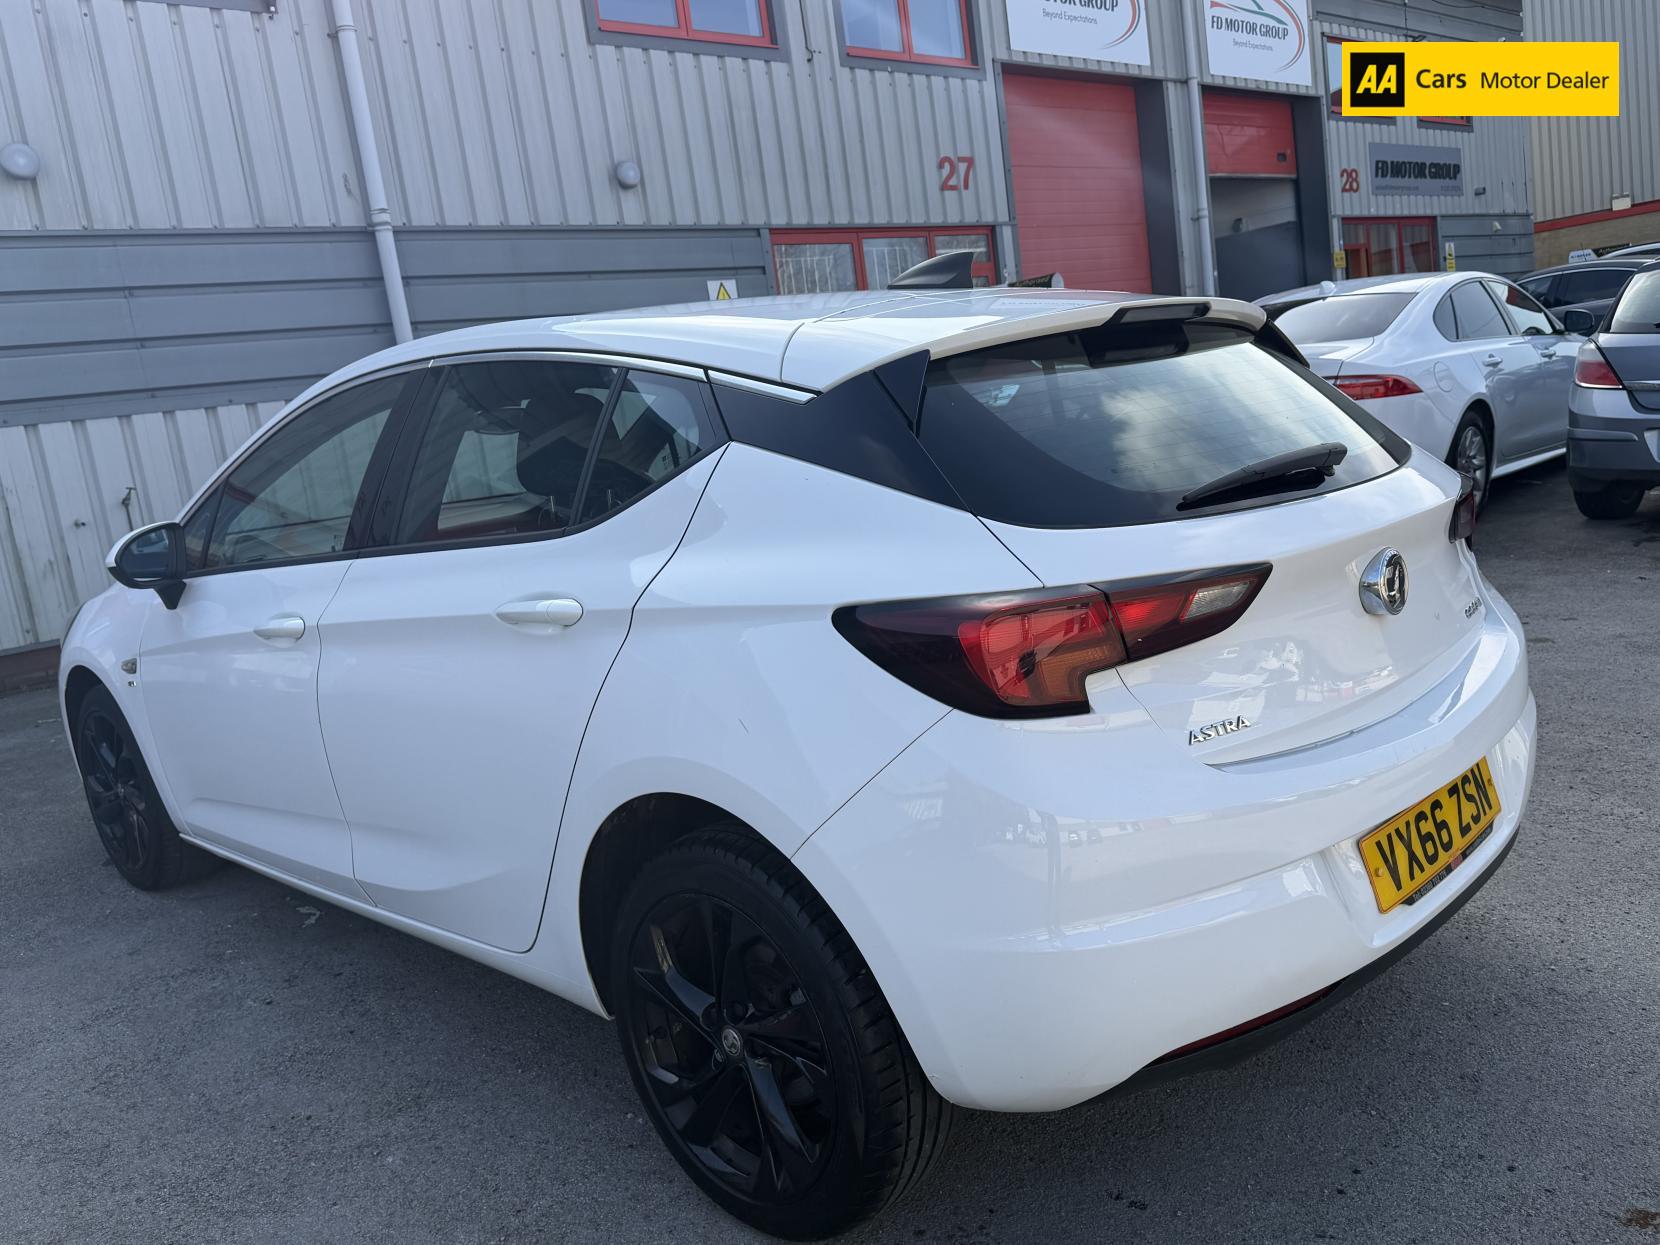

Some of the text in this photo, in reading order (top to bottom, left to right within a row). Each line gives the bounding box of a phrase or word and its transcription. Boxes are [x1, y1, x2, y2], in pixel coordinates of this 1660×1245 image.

[1042, 8, 1098, 24] Beyond Expectations
[1211, 15, 1289, 40] FD MOTOR GROUP
[938, 156, 974, 191] 27
[1340, 168, 1360, 193] 28
[1375, 160, 1461, 181] FD MOTOR GROUP
[1187, 714, 1251, 746] ASTRA
[1375, 763, 1493, 892] VX66 ZSN
